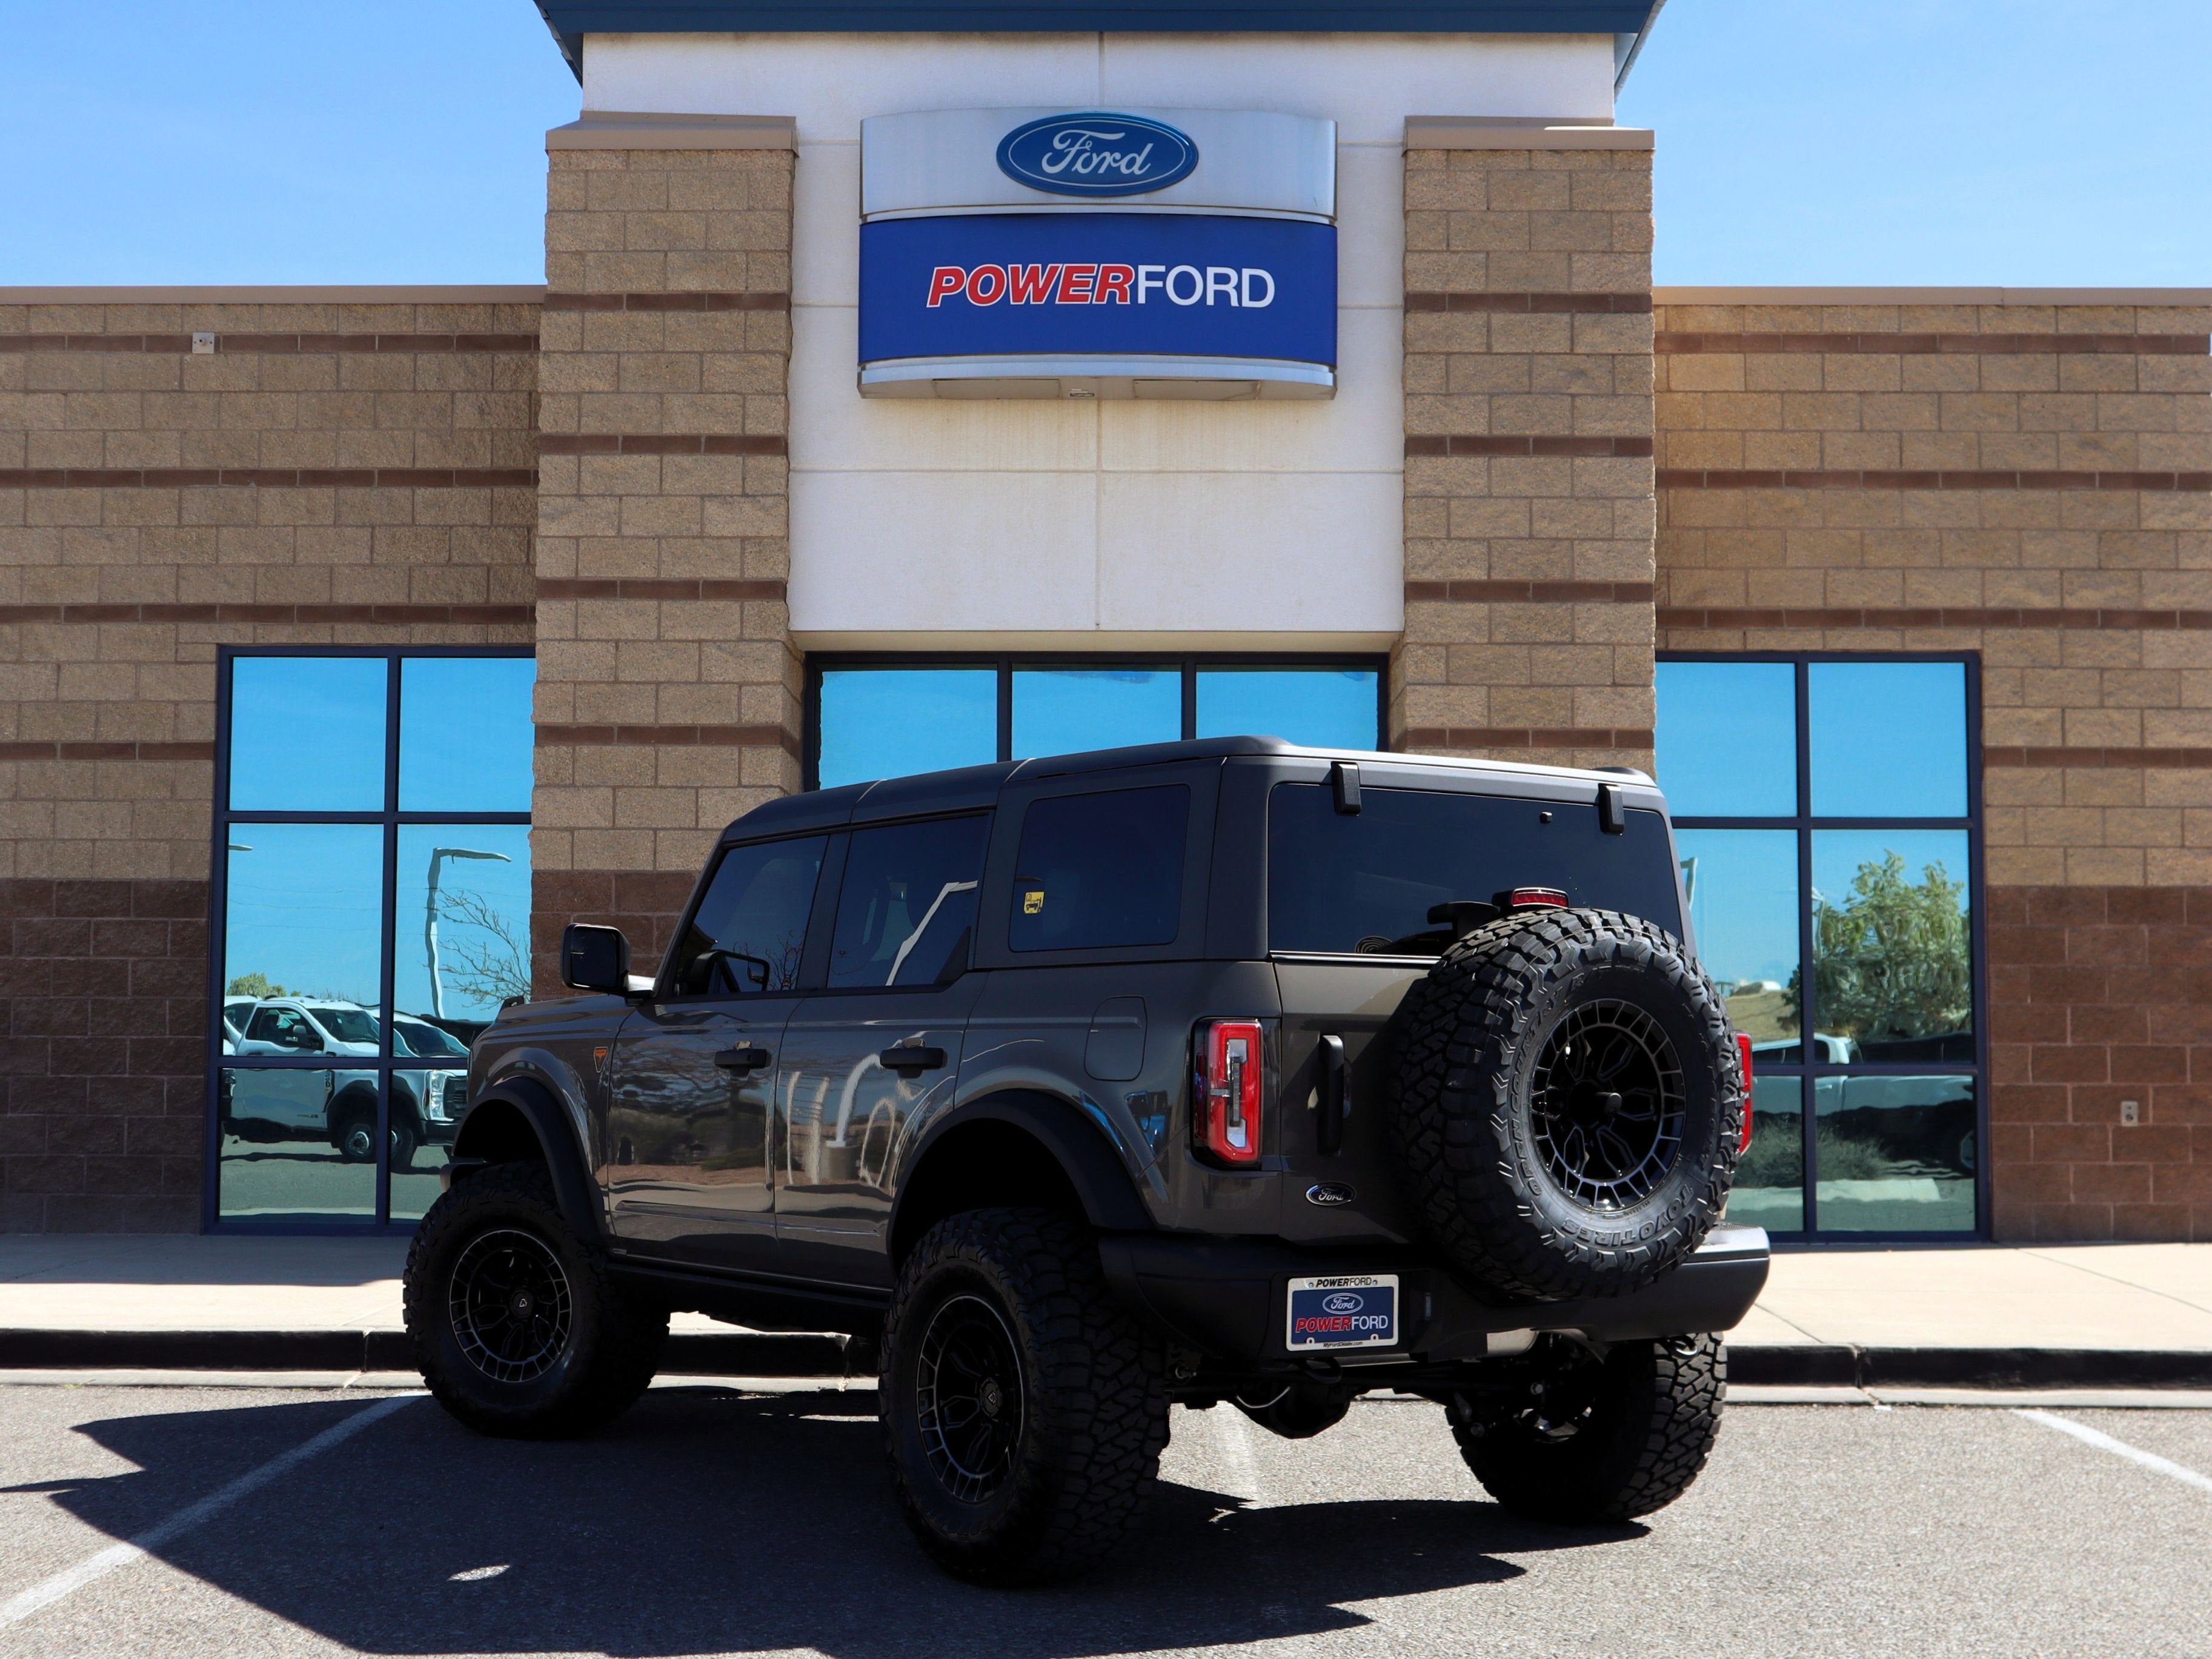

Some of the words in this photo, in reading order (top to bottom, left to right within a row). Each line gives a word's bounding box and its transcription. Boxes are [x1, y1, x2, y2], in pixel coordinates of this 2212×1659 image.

[1041, 129, 1154, 176] Ford
[926, 264, 1275, 308] POWERFORD
[1318, 1187, 1344, 1202] Ford
[1316, 1277, 1372, 1288] POWERFORD
[1330, 1296, 1356, 1310] Ford
[1295, 1315, 1389, 1333] POWERFORD
